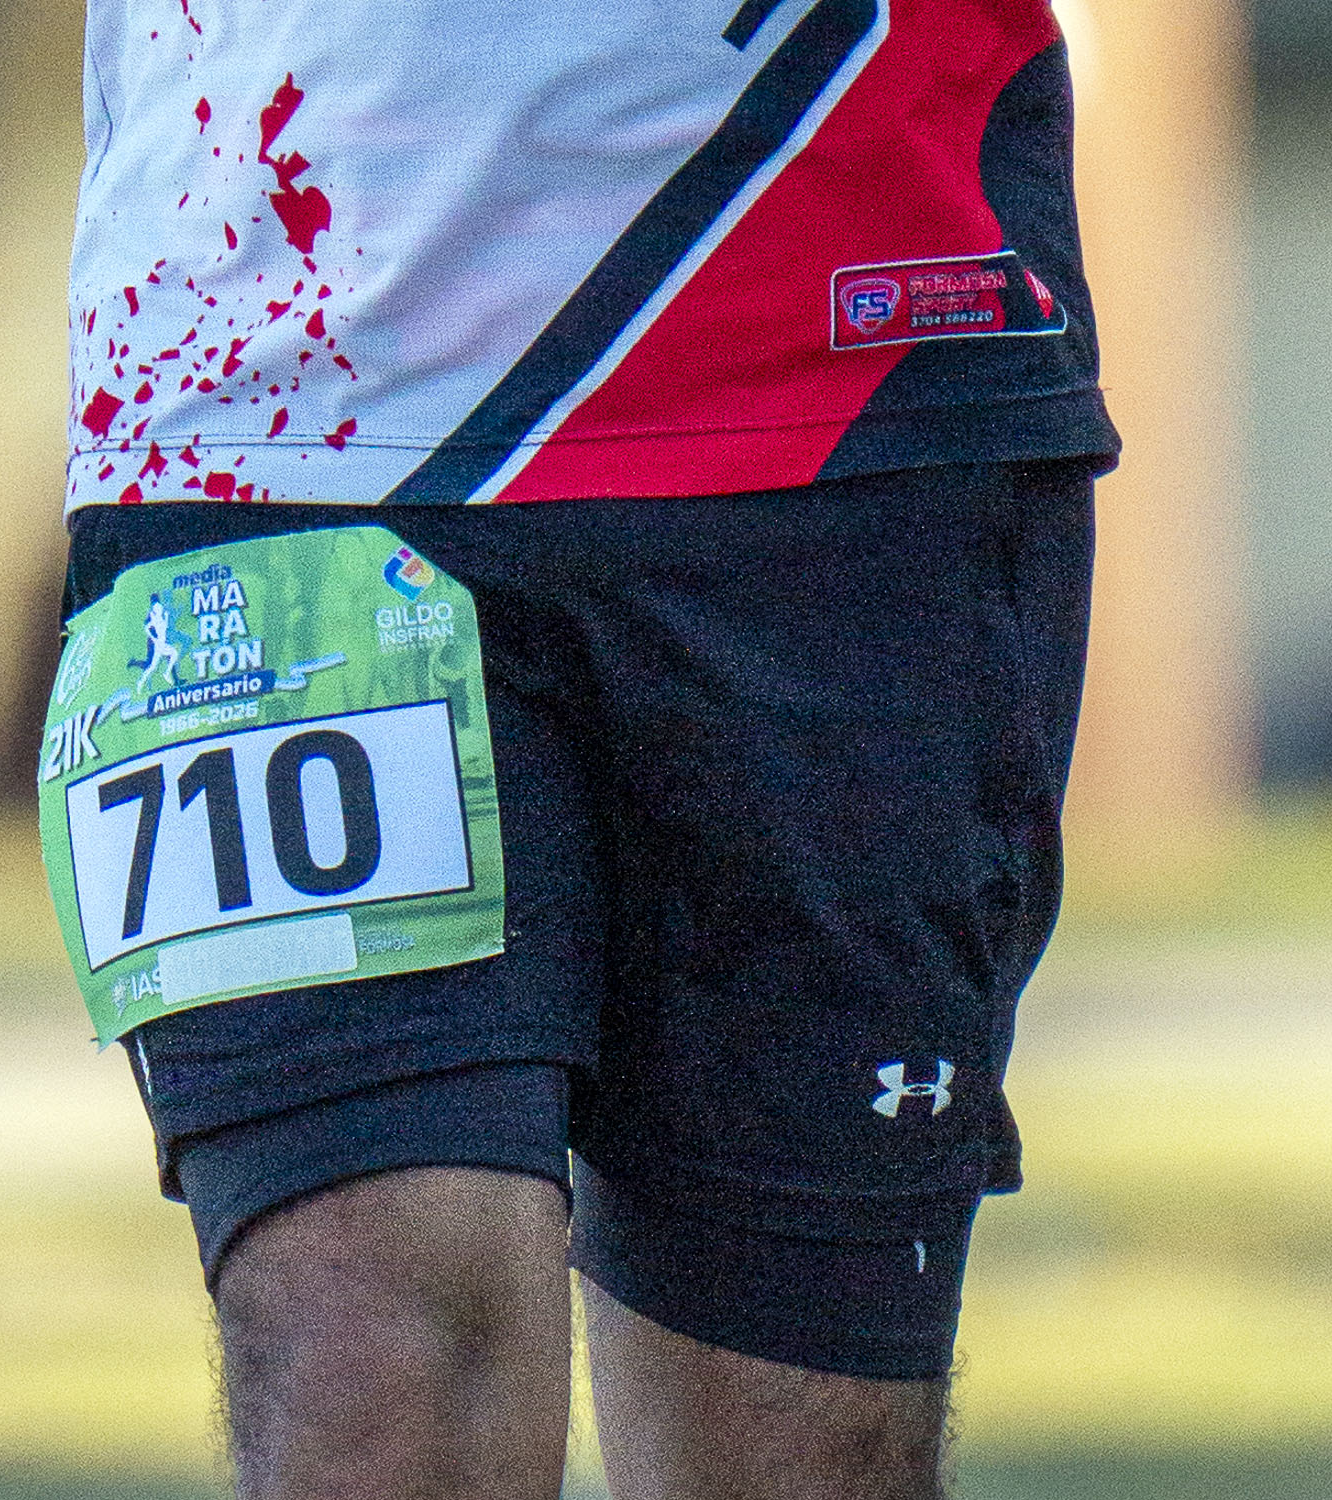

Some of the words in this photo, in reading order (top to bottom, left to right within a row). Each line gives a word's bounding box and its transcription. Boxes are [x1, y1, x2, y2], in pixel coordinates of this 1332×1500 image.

[173, 563, 233, 589] media
[192, 579, 246, 616] MA
[375, 601, 454, 629] GILDO
[198, 607, 248, 643] RA
[153, 674, 263, 714] Aniversario
[43, 703, 101, 783] 21K
[99, 729, 382, 940] 710
